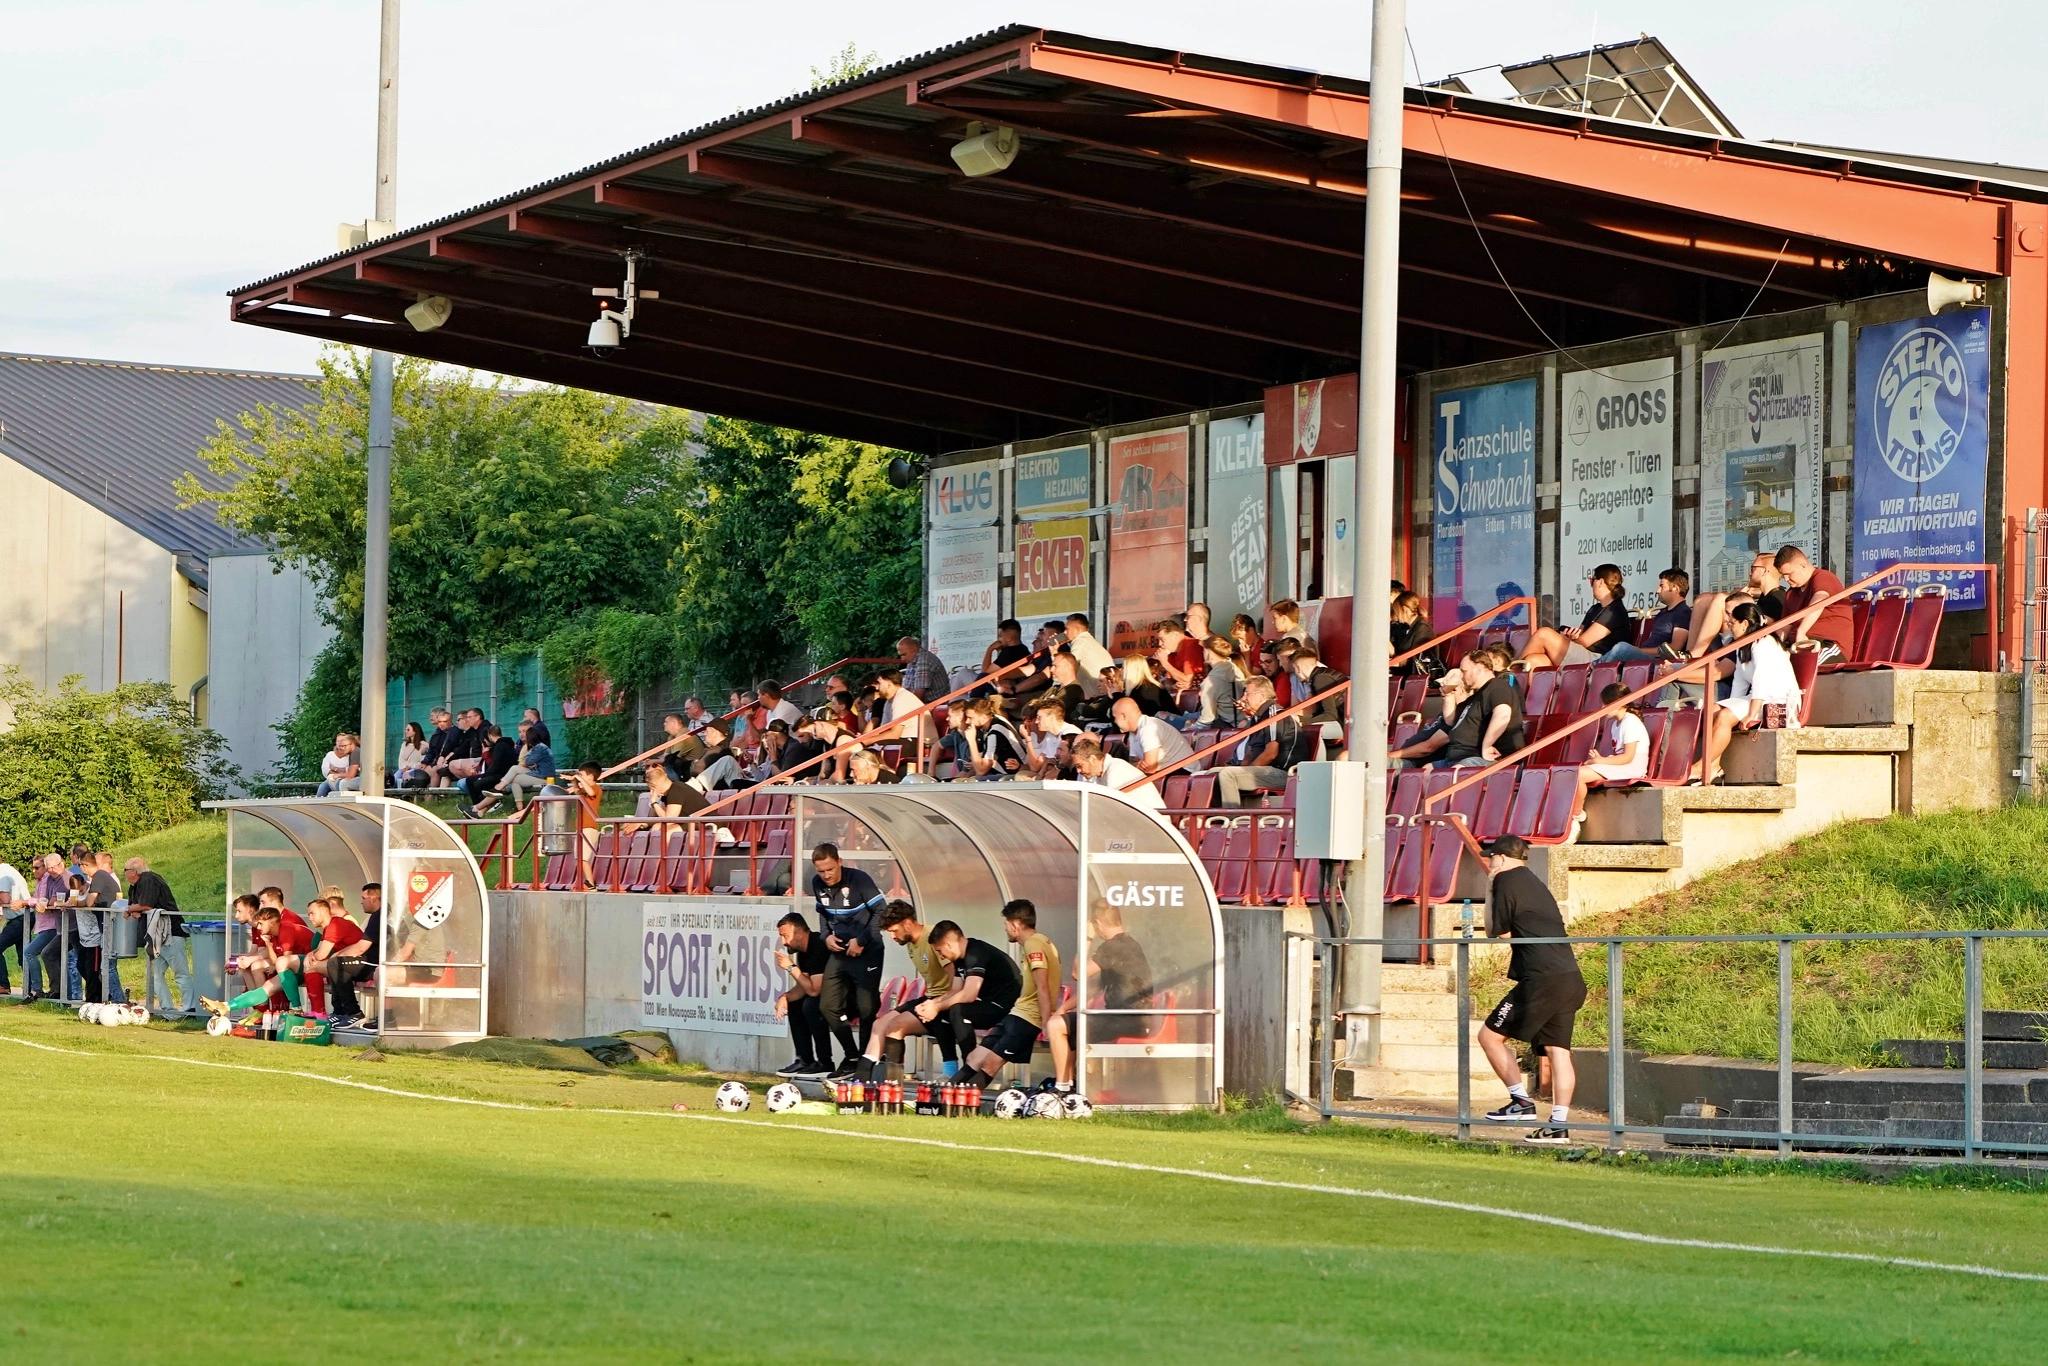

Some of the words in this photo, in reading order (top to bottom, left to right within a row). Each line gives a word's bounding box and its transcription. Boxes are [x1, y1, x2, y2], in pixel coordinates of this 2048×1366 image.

[1881, 337, 1962, 407] STEKO
[1596, 388, 1667, 431] GROSS
[1440, 401, 1533, 463] Tanzschule
[1019, 456, 1060, 481] ELEKTRO
[1572, 456, 1617, 482] Fenster
[1626, 450, 1662, 475] Türen
[1886, 429, 1958, 479] TRANS
[935, 470, 993, 517] KLUG
[1044, 475, 1087, 499] HEIZUNG
[1438, 447, 1532, 515] Schwebach
[1578, 483, 1654, 514] Garagentore
[1880, 498, 1905, 516] WIR
[1908, 492, 1960, 513] TRAGEN
[1231, 499, 1265, 546] BESTE
[1863, 509, 1977, 536] VERANTWORTUNG
[1577, 538, 1598, 555] 2201
[1600, 532, 1653, 556] Kapellerfeld
[1861, 549, 1879, 561] 1160
[1965, 540, 1976, 553] 46
[1017, 535, 1087, 593] ECKER
[1636, 559, 1648, 575] 44
[1106, 880, 1185, 907] GÄSTE
[670, 913, 680, 928] IHR
[682, 913, 711, 929] SPEZIALIST
[713, 913, 724, 930] FÜR
[726, 914, 760, 931] TEAMSPORT
[644, 931, 713, 998] SPORT
[737, 935, 787, 1004] RISS
